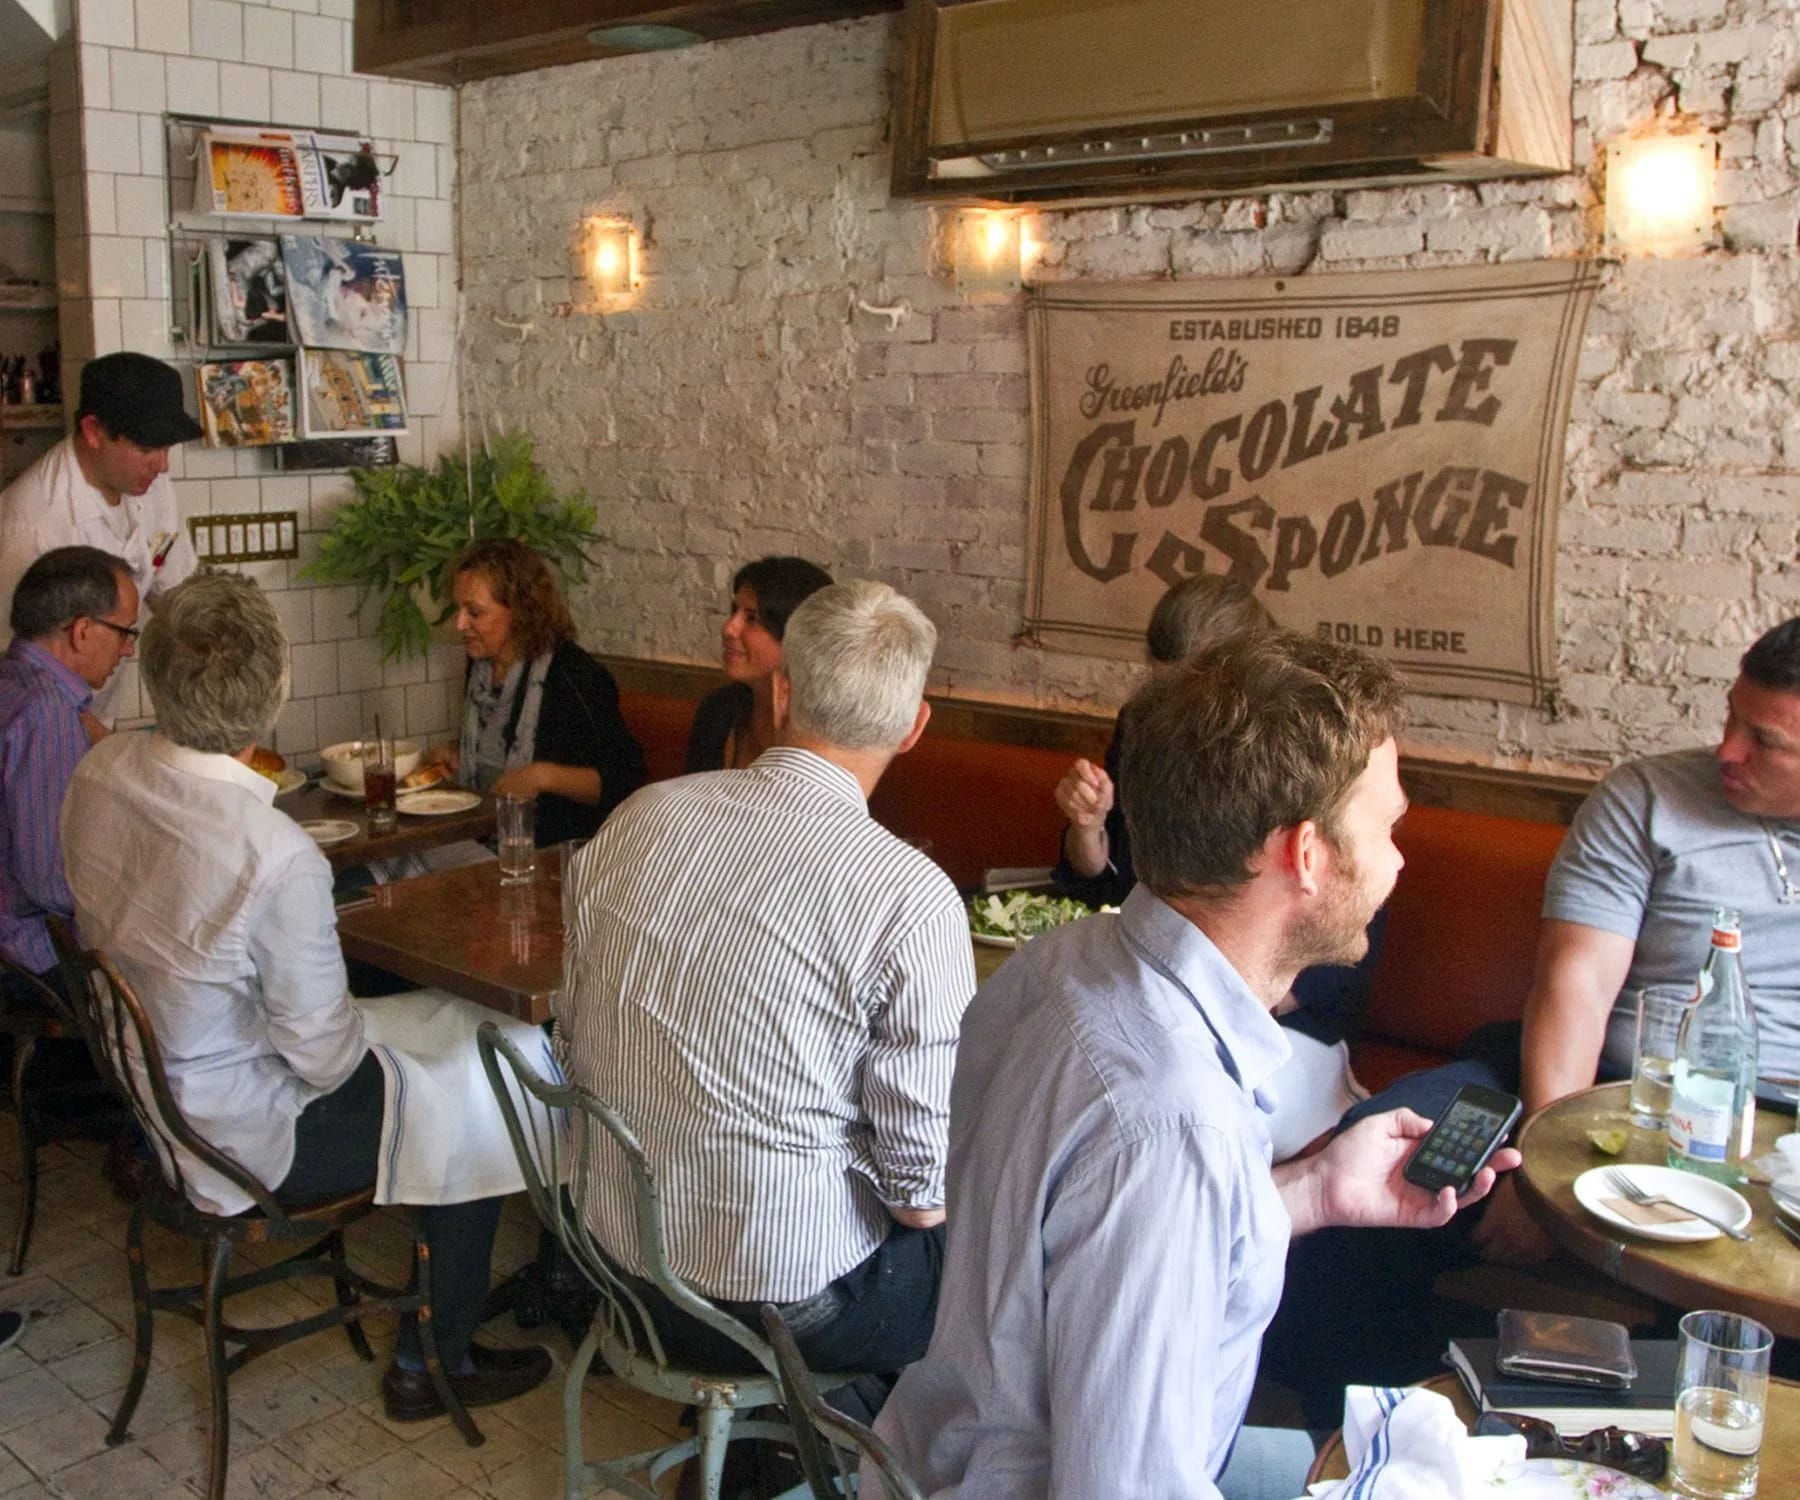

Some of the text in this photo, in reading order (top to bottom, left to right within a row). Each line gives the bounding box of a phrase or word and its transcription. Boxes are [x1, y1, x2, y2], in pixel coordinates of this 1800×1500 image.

[1169, 315, 1400, 341] ESTABLISHED 1848
[1079, 347, 1249, 428] Greenfield's
[1060, 338, 1518, 583] CHOCOLATE
[1144, 464, 1531, 592] SPONGE
[1316, 621, 1469, 654] SOLD HERE
